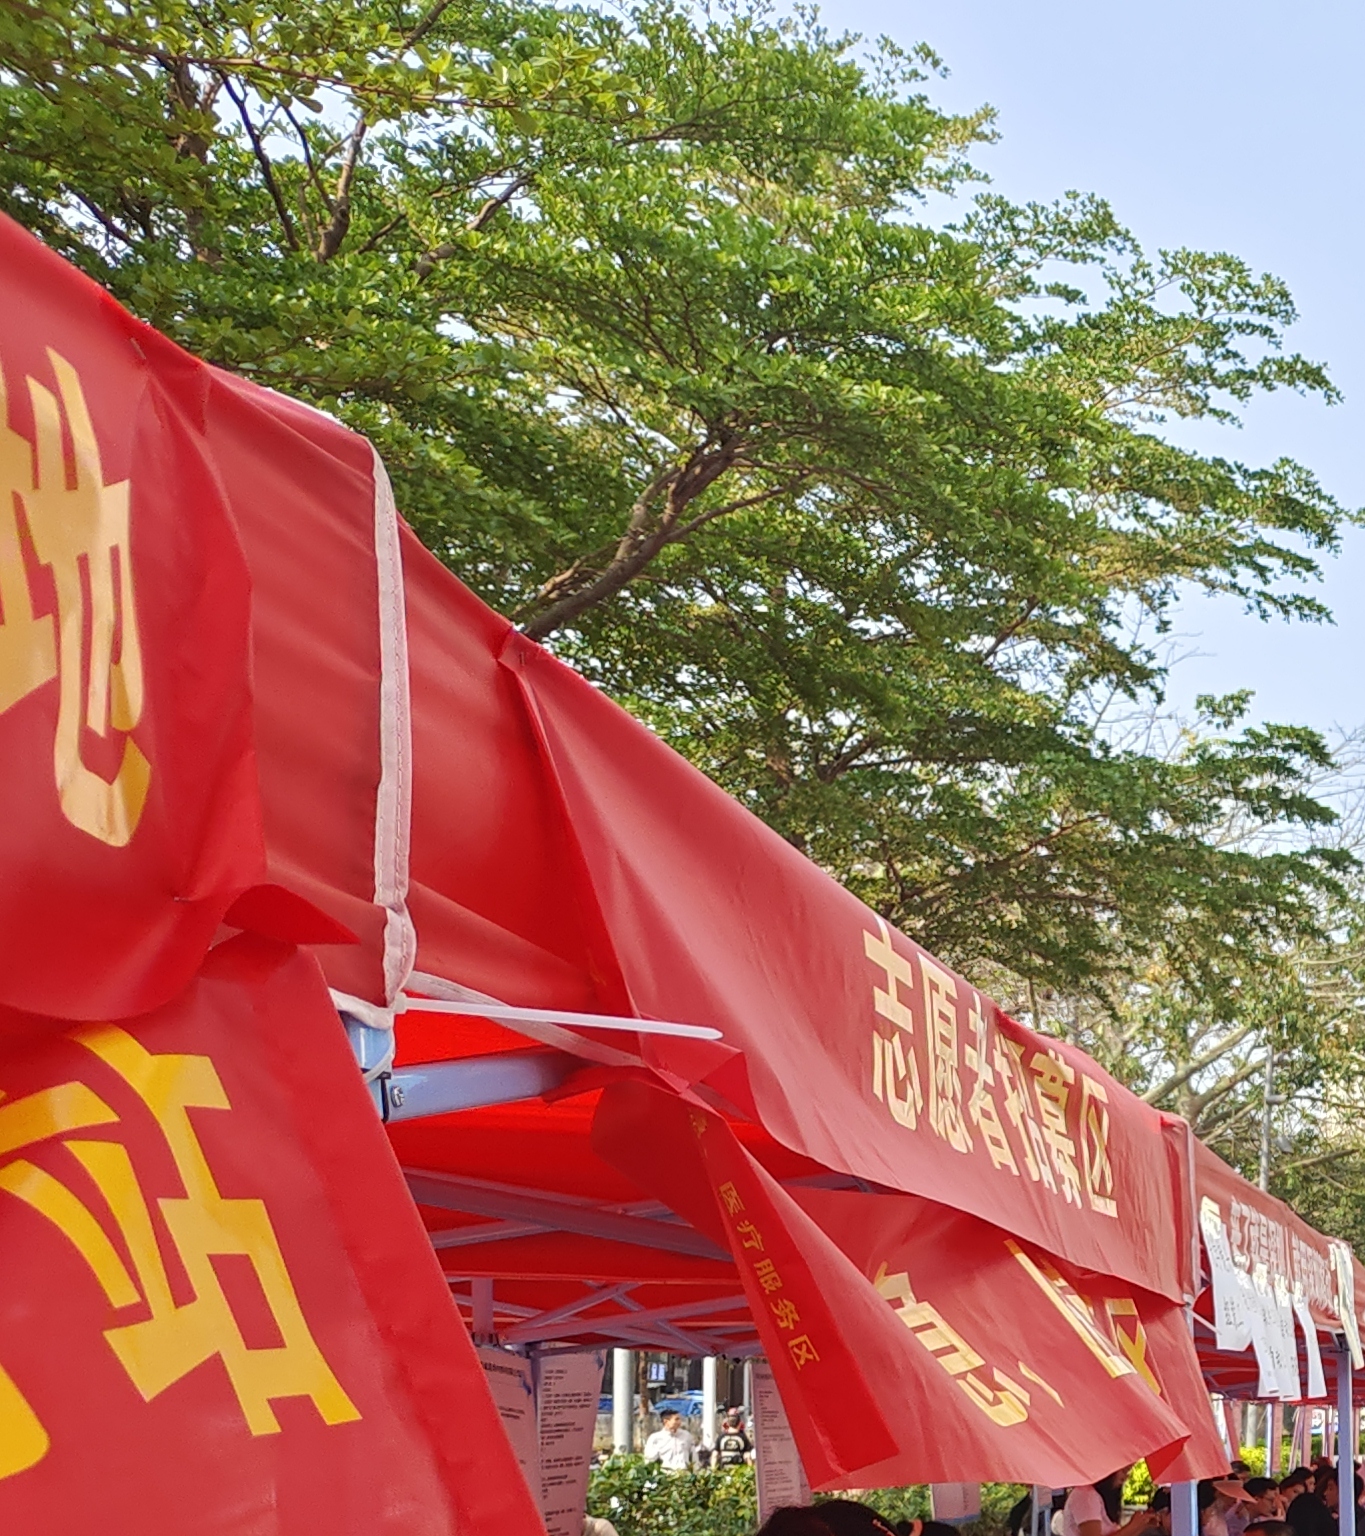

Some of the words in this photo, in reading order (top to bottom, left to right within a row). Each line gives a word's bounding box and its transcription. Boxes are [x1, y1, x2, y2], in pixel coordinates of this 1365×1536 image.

[862, 912, 1118, 1218] 志愿者招募区
[0, 1022, 362, 1480] 站
[718, 1180, 820, 1371] 医疗服务区
